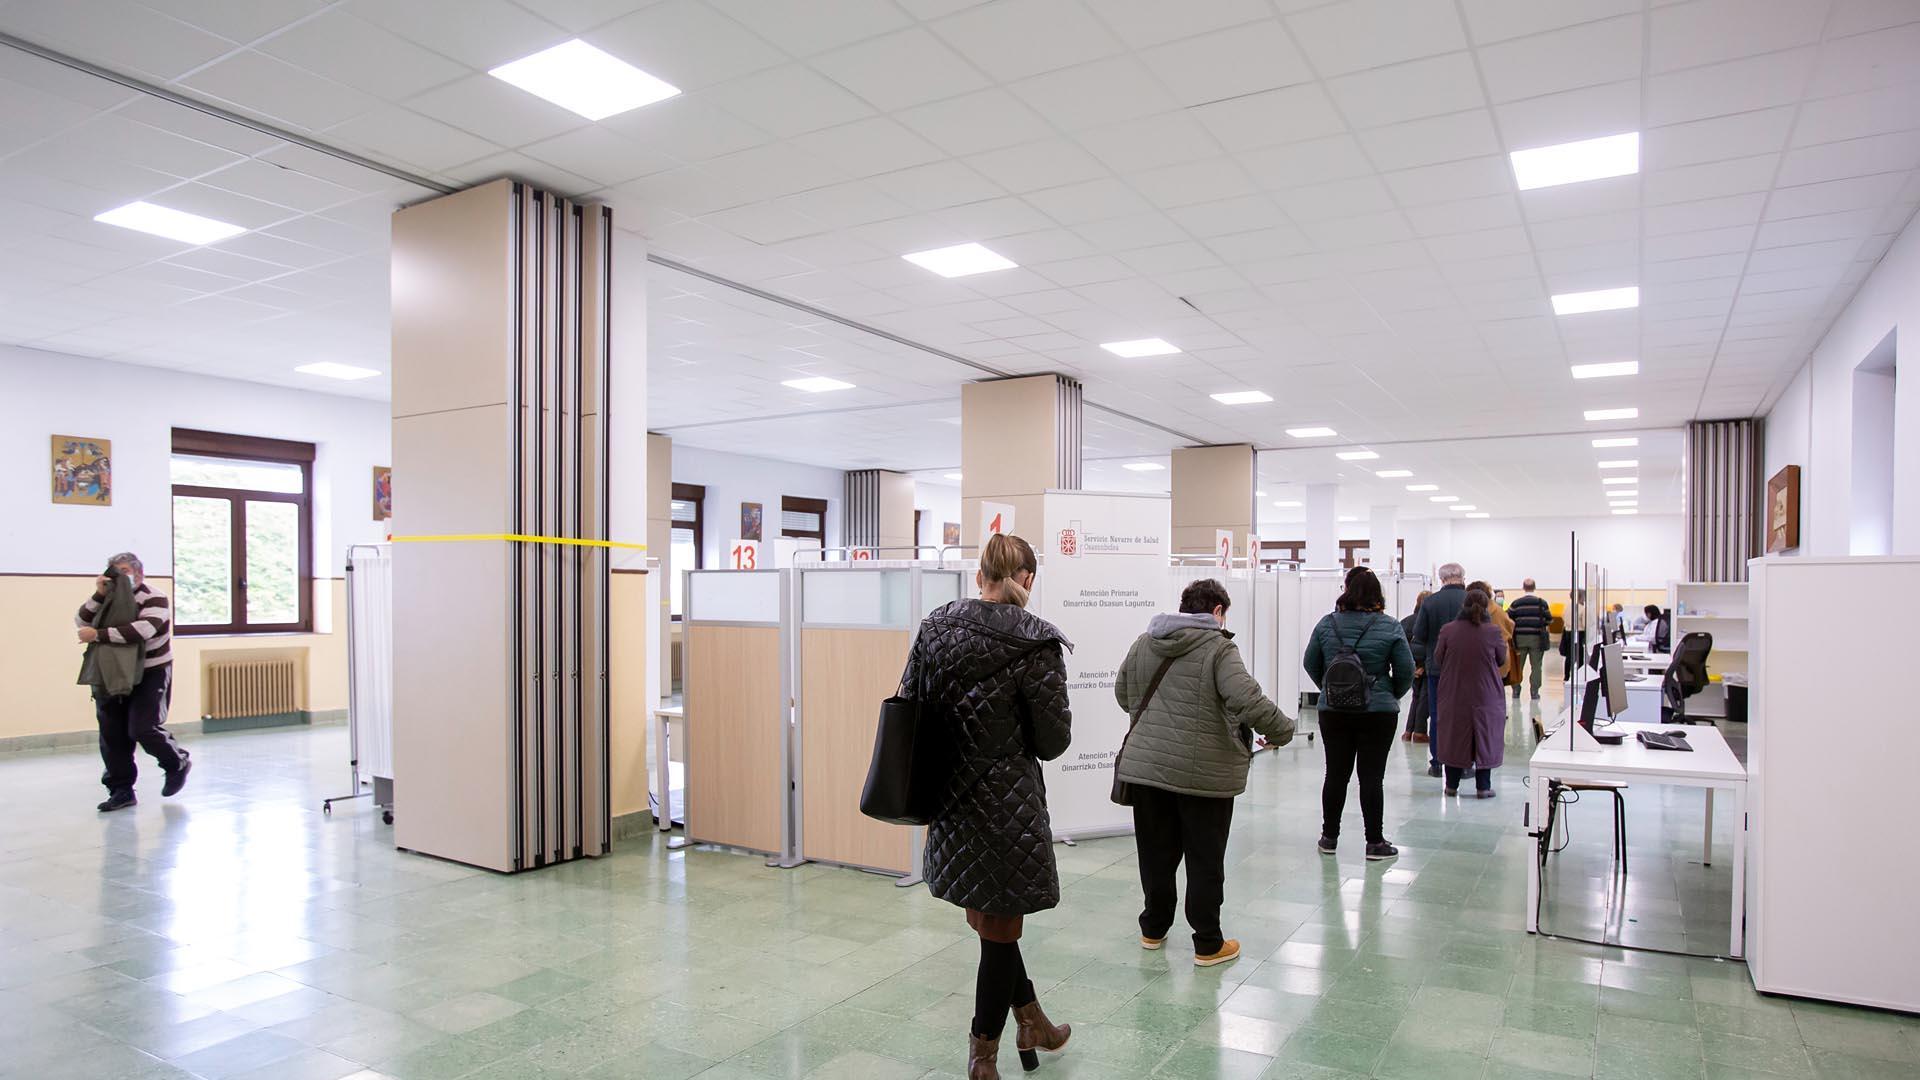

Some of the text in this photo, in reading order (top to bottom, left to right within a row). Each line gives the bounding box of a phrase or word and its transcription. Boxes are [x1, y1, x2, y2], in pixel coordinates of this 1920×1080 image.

[1144, 536, 1159, 544] Salud
[732, 545, 756, 570] 13
[1079, 589, 1139, 597] Atención Primaria
[1063, 599, 1155, 609] Oinarrizko Osasun Laguntza
[1079, 671, 1109, 679] Atención
[1067, 682, 1097, 690] inarrizko
[1078, 752, 1108, 760] Atención
[1061, 763, 1096, 772] Oinarrizko
